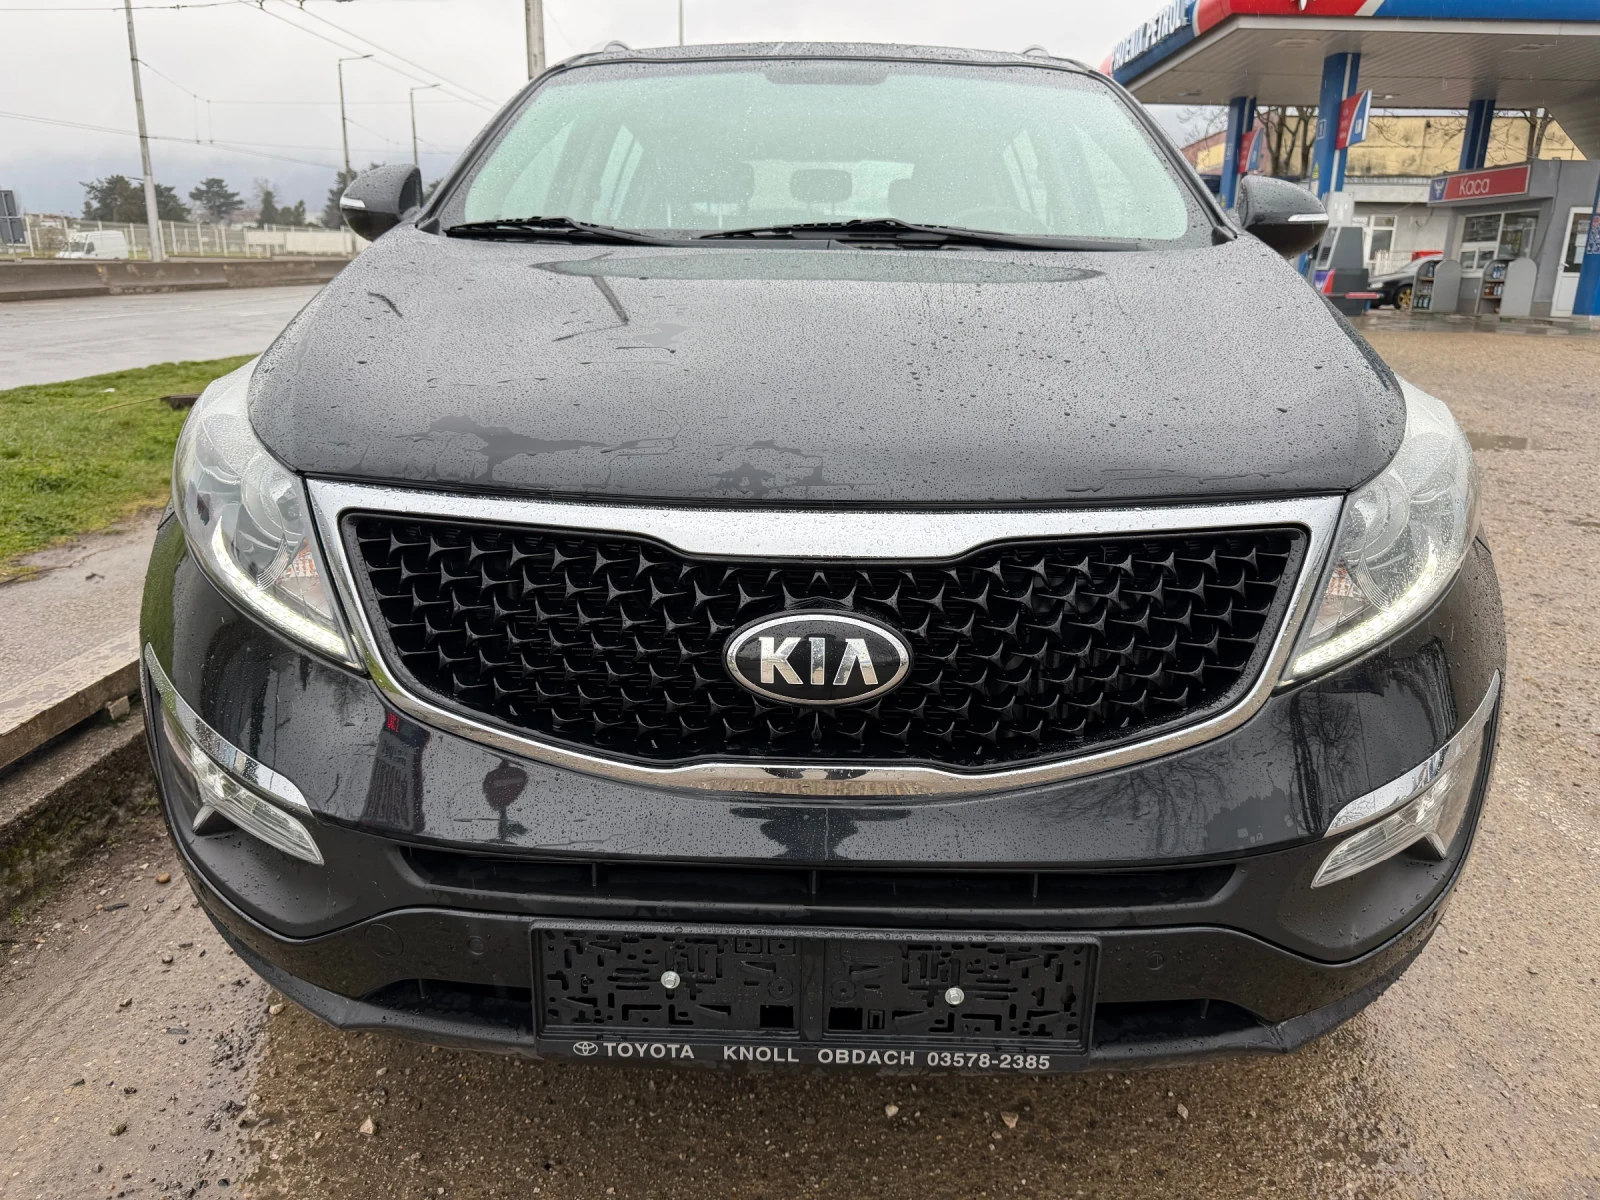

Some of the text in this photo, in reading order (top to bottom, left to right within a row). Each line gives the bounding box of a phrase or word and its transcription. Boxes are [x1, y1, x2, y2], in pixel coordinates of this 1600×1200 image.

[1459, 178, 1490, 195] Каса
[758, 636, 879, 686] KIA
[603, 1042, 1050, 1070] TOYOTA KNOLL OBDACH 03578-2385
